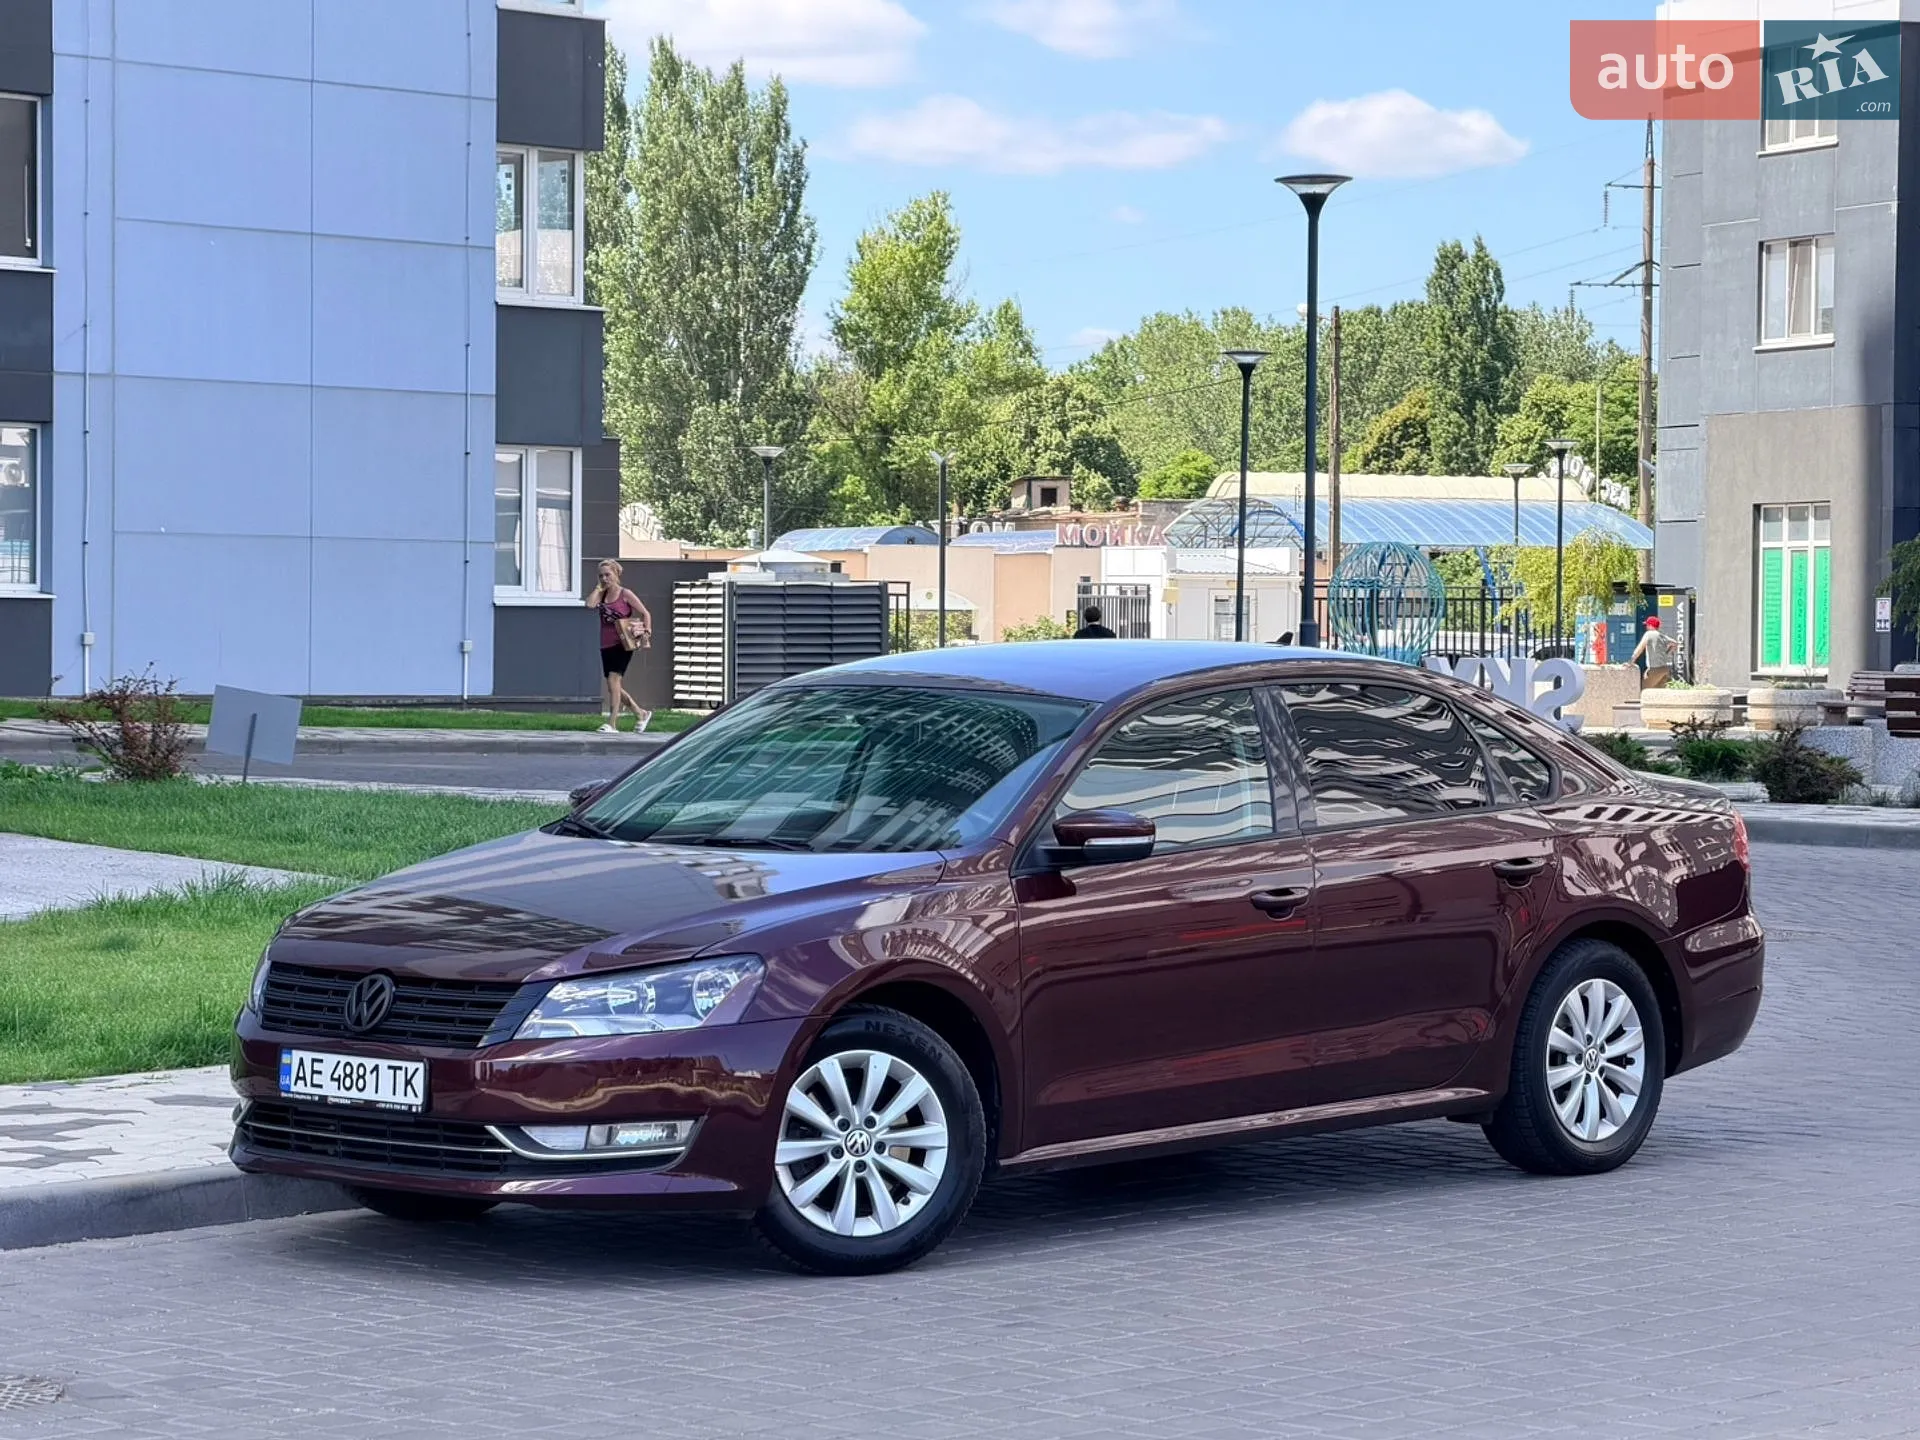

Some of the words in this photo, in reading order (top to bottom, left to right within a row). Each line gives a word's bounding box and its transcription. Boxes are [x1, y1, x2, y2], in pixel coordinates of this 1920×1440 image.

[1056, 520, 1168, 546] МОЙКА
[864, 1020, 943, 1060] NEXEN
[294, 1056, 324, 1089] AE
[330, 1060, 380, 1094] 4881
[387, 1065, 420, 1098] TK
